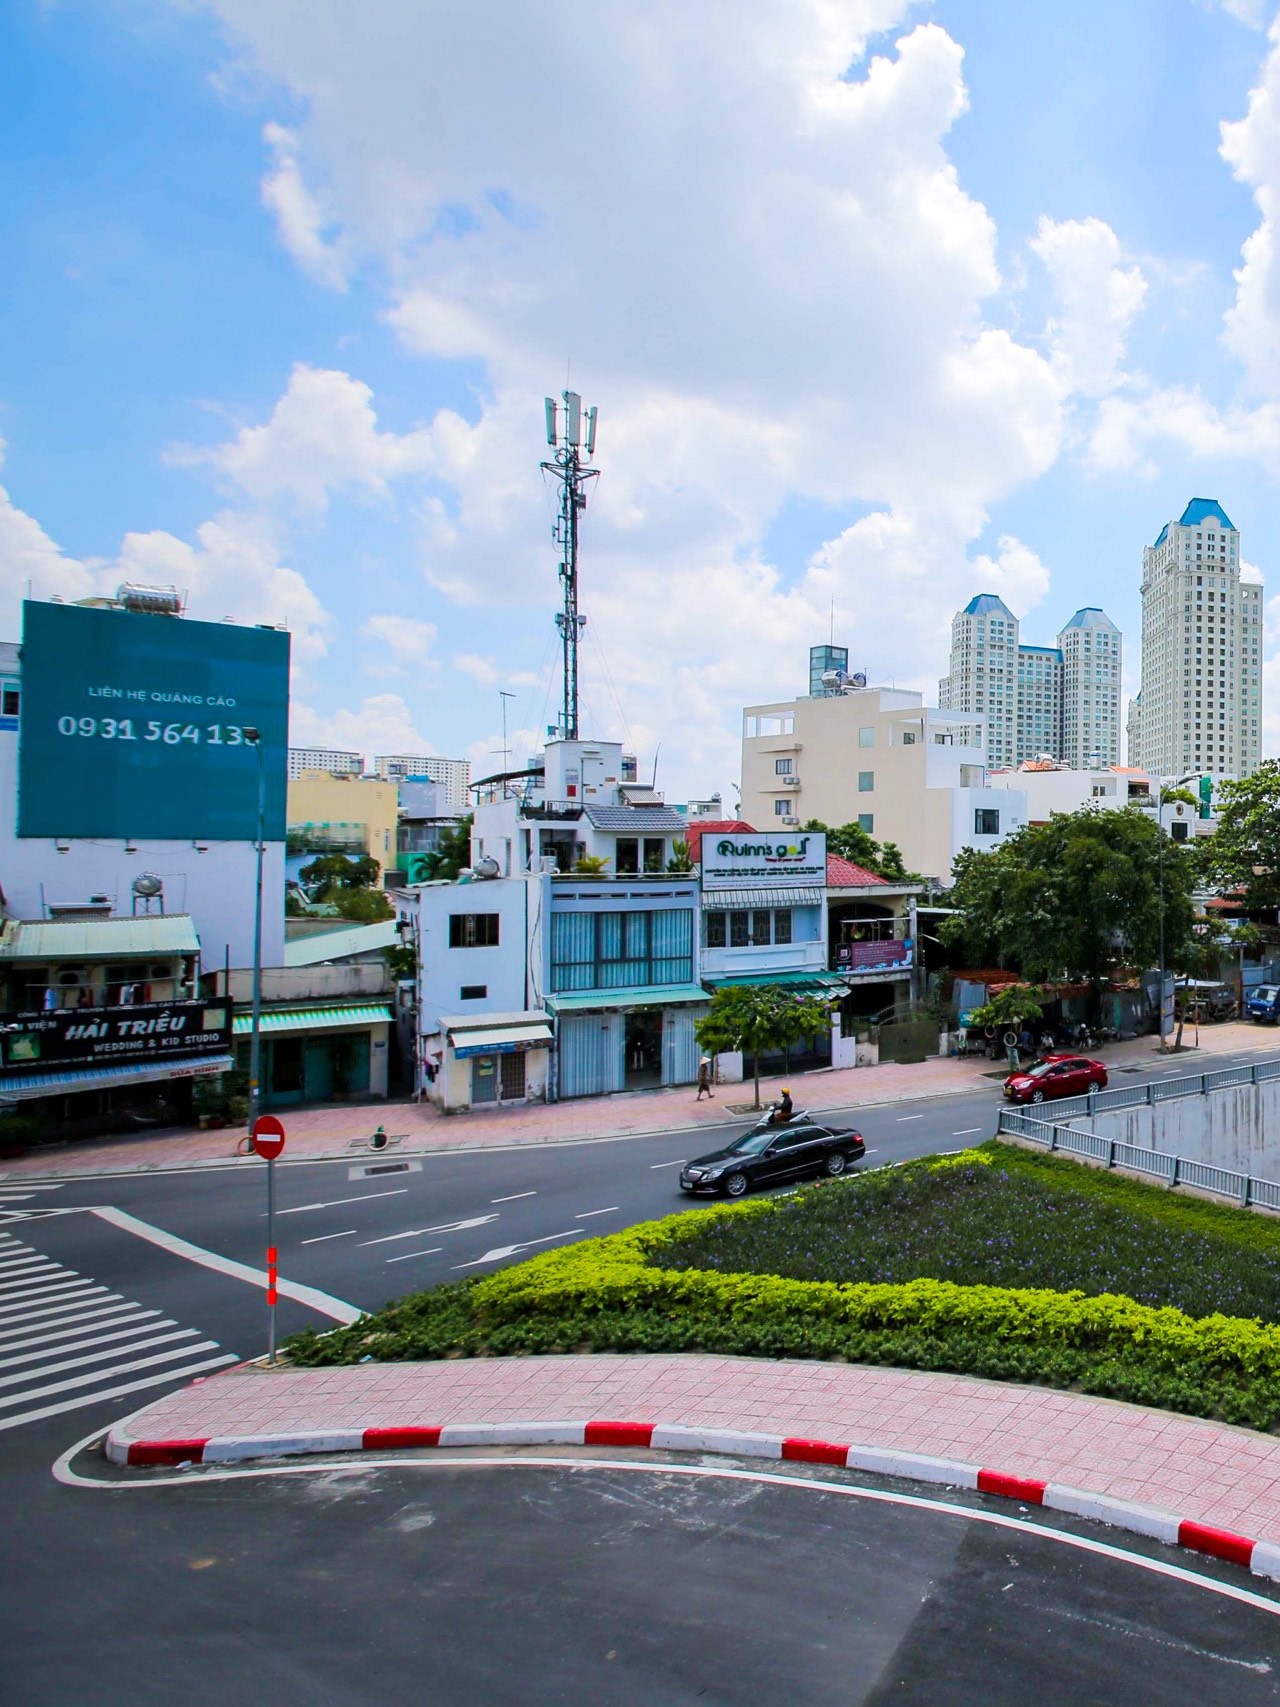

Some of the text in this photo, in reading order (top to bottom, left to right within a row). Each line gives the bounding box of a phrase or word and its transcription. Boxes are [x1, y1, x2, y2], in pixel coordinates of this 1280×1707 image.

[88, 686, 122, 698] LIÊN
[127, 690, 147, 702] HỆ
[57, 716, 137, 740] 0931
[144, 721, 200, 744] 564
[776, 837, 811, 858] golf
[64, 1010, 186, 1040] HẢI TRIỀU
[94, 1033, 220, 1053] WEDDING & KID STUDIO
